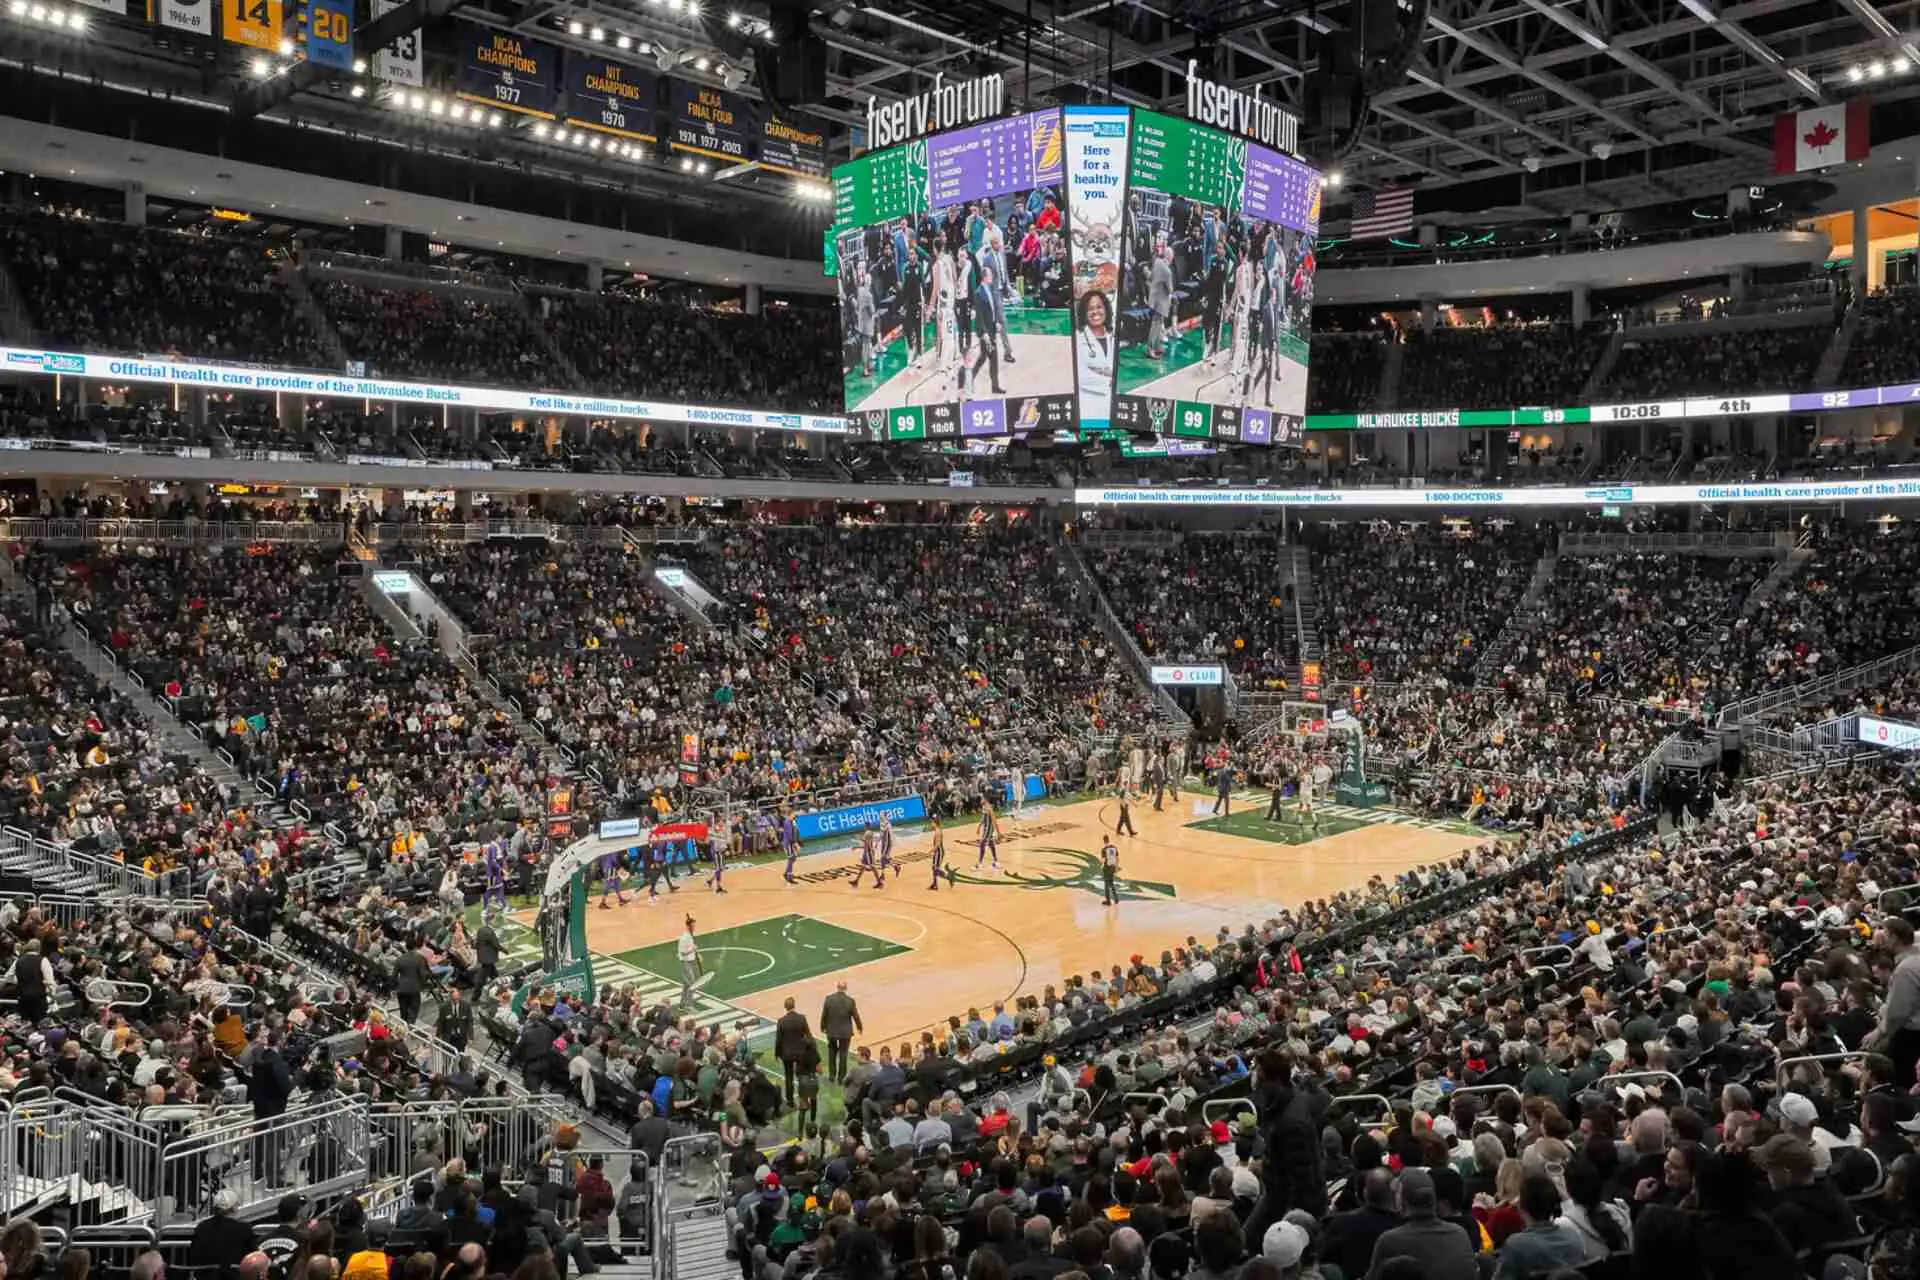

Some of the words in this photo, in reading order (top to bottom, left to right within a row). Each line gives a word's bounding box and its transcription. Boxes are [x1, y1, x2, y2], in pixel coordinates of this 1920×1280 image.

[313, 8, 349, 44] 20
[493, 36, 522, 56] NCAA
[478, 46, 537, 75] CHAMPIONS
[606, 64, 620, 81] NIT
[495, 84, 521, 104] 1977
[585, 74, 640, 100] CHAMPIONS
[601, 110, 625, 128] 1970
[700, 135, 720, 150] 1977
[1083, 145, 1110, 156] Here
[1083, 159, 1099, 170] for
[1103, 161, 1110, 170] a
[1074, 173, 1119, 186] healthy
[1083, 189, 1108, 200] you.
[110, 362, 166, 378] Official
[171, 367, 218, 382] health
[222, 373, 252, 385] care
[256, 374, 313, 390] provider
[317, 378, 329, 391] of
[332, 379, 354, 393] the
[357, 383, 424, 399] Milwaukee
[426, 387, 461, 401] Bucks
[529, 396, 551, 408] Feel
[553, 399, 573, 411] like
[574, 402, 581, 411] a
[1719, 399, 1751, 413] 4th
[1821, 392, 1850, 407] 92
[934, 406, 950, 418] 4th
[971, 409, 995, 427] 92
[1183, 410, 1204, 428] 99
[1356, 411, 1420, 428] MILWAUKEE
[1421, 409, 1460, 427] BUCKS
[1611, 405, 1661, 419] 10:08
[896, 415, 916, 432] 99
[1248, 418, 1265, 435] 92
[1103, 488, 1138, 500] Official
[1140, 488, 1169, 500] health
[1171, 490, 1191, 501] care
[1192, 490, 1231, 504] provider
[1698, 487, 1740, 499] Official
[1743, 487, 1781, 497] health
[1784, 488, 1810, 498] care
[1814, 484, 1858, 500] provider
[1862, 483, 1874, 495] of
[1876, 483, 1895, 495] the
[1190, 671, 1217, 681] CLUB
[818, 815, 839, 832] GE
